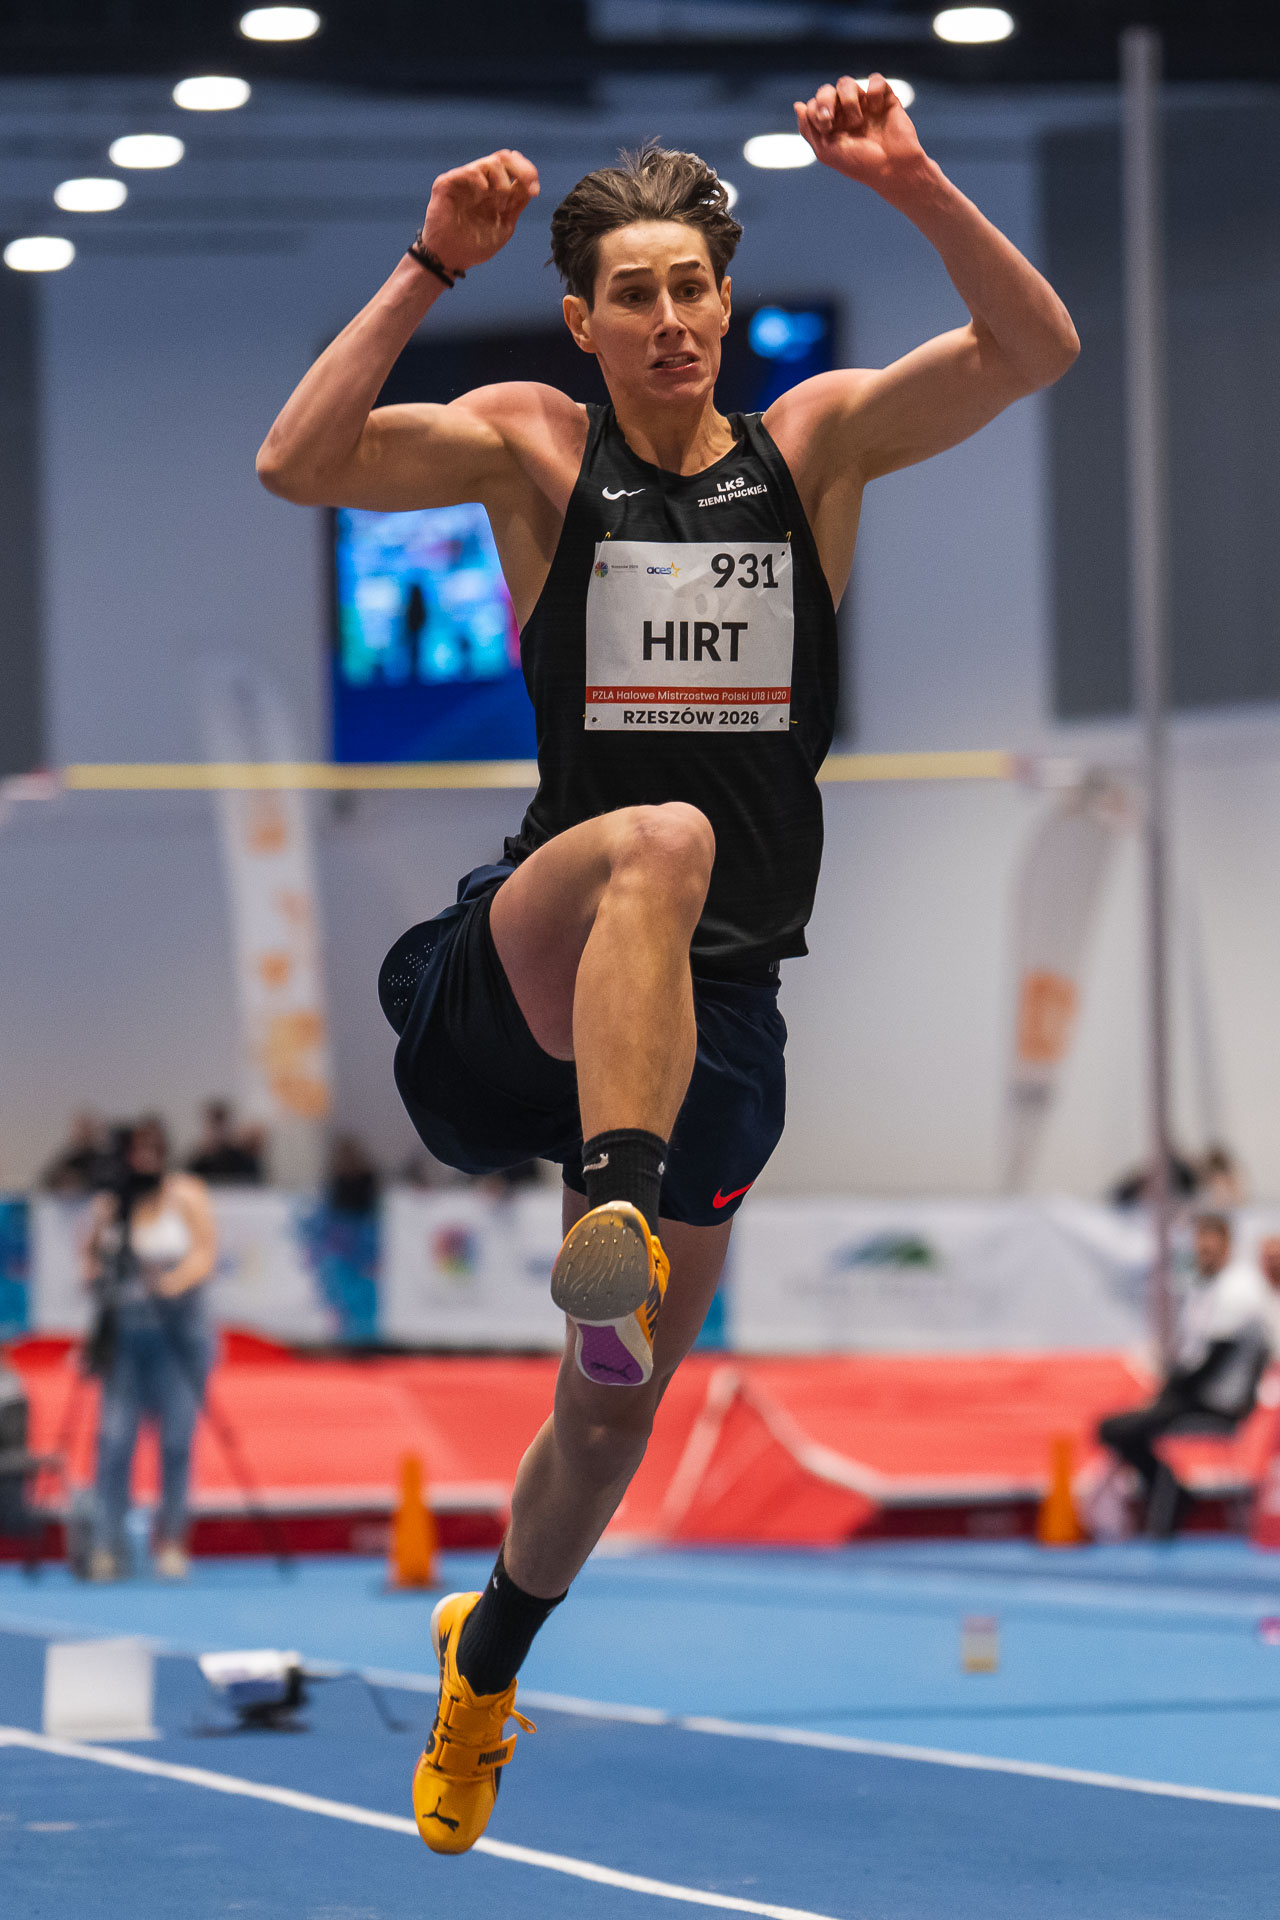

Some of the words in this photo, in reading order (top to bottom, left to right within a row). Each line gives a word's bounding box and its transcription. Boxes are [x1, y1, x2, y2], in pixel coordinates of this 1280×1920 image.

[716, 477, 745, 492] LKS
[698, 495, 727, 507] ZIEMI
[727, 484, 768, 501] PUCKIEJ
[646, 566, 672, 575] aces
[711, 553, 778, 588] 931
[643, 621, 748, 661] HIRT
[592, 690, 614, 700] PZLA
[616, 690, 655, 700] Halowe
[658, 690, 720, 701] Mistrzostwa
[721, 691, 749, 701] Polski
[751, 691, 766, 701] U18
[771, 690, 787, 700] U20
[623, 707, 714, 725] RZESZÓW
[718, 710, 759, 725] 2026
